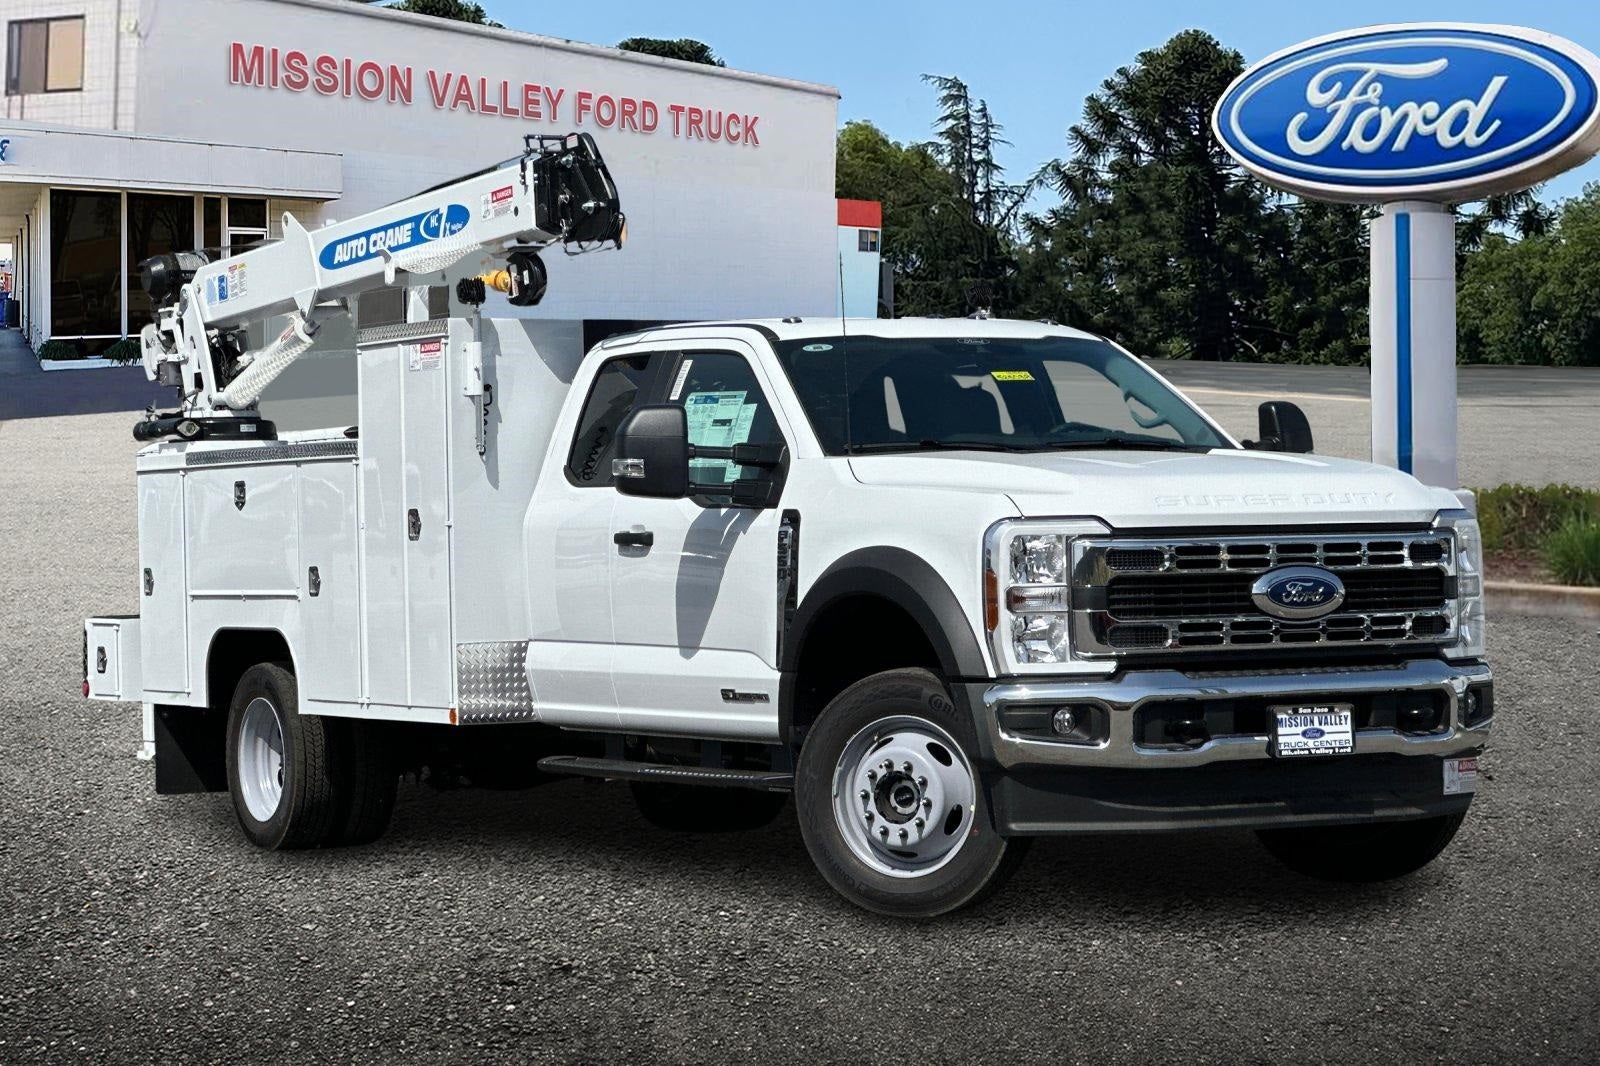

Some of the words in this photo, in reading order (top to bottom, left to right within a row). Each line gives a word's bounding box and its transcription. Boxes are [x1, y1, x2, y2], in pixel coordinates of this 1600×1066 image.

[230, 41, 413, 105] MISSION
[427, 68, 565, 122] VALLEY
[576, 90, 659, 134] FORD
[668, 104, 760, 146] TRUCK
[1286, 58, 1508, 156] Ford
[333, 236, 367, 264] AUTO
[369, 222, 412, 254] CRANE
[1154, 493, 1291, 508] SUPER
[1302, 490, 1398, 506] DUTY
[1282, 581, 1324, 602] Ford
[1277, 716, 1315, 729] MISSION
[1317, 714, 1349, 727] VALLEY
[1305, 729, 1320, 738] Ford
[1279, 741, 1310, 749] TRUCK
[1312, 739, 1351, 747] CENTER
